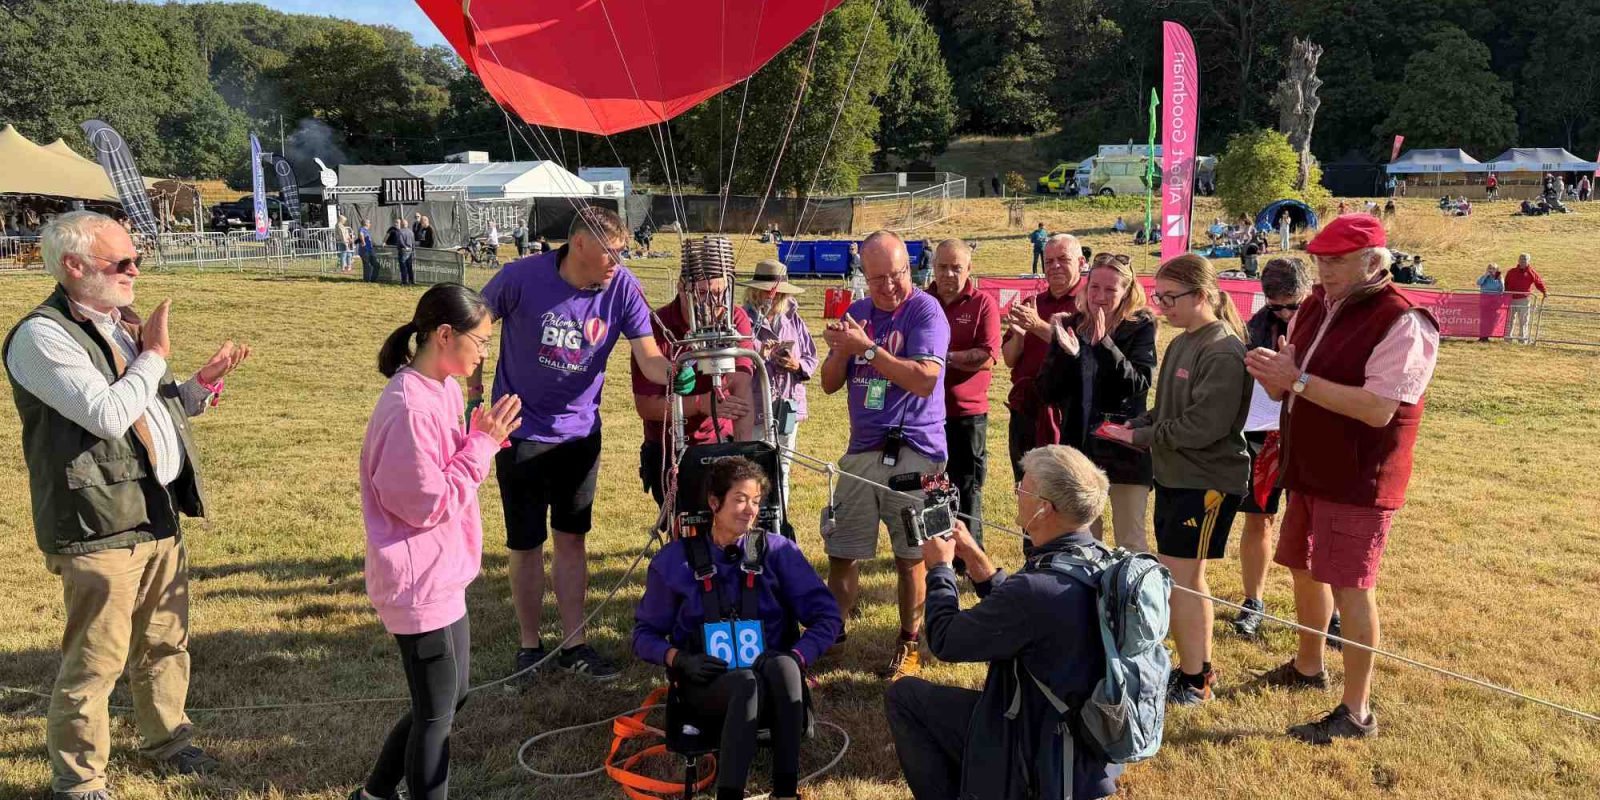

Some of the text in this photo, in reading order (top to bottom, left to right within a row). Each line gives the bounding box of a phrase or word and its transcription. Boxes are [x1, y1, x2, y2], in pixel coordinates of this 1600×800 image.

[1428, 304, 1462, 315] Albert
[541, 311, 584, 329] Paloma's
[1440, 316, 1481, 325] odman
[541, 326, 582, 349] BIG
[539, 356, 589, 372] CHALLENGE
[710, 628, 761, 665] 68
